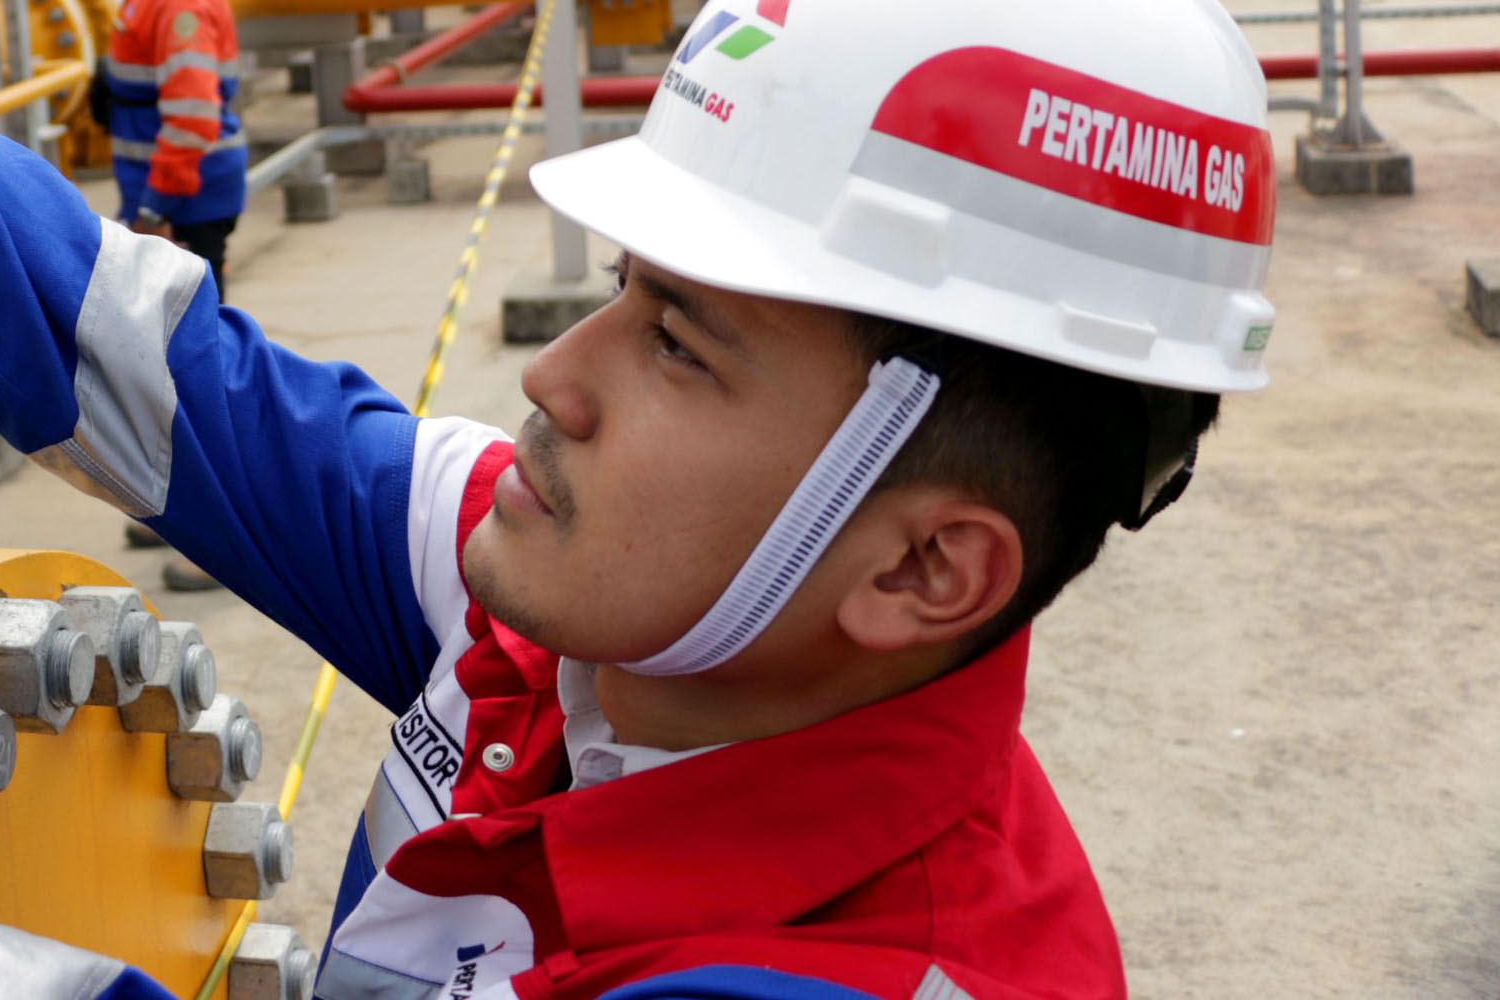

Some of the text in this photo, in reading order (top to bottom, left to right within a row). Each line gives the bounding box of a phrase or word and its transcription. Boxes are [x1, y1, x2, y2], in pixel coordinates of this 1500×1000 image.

[705, 92, 734, 123] GAS
[1017, 87, 1245, 213] PERTAMINA GAS
